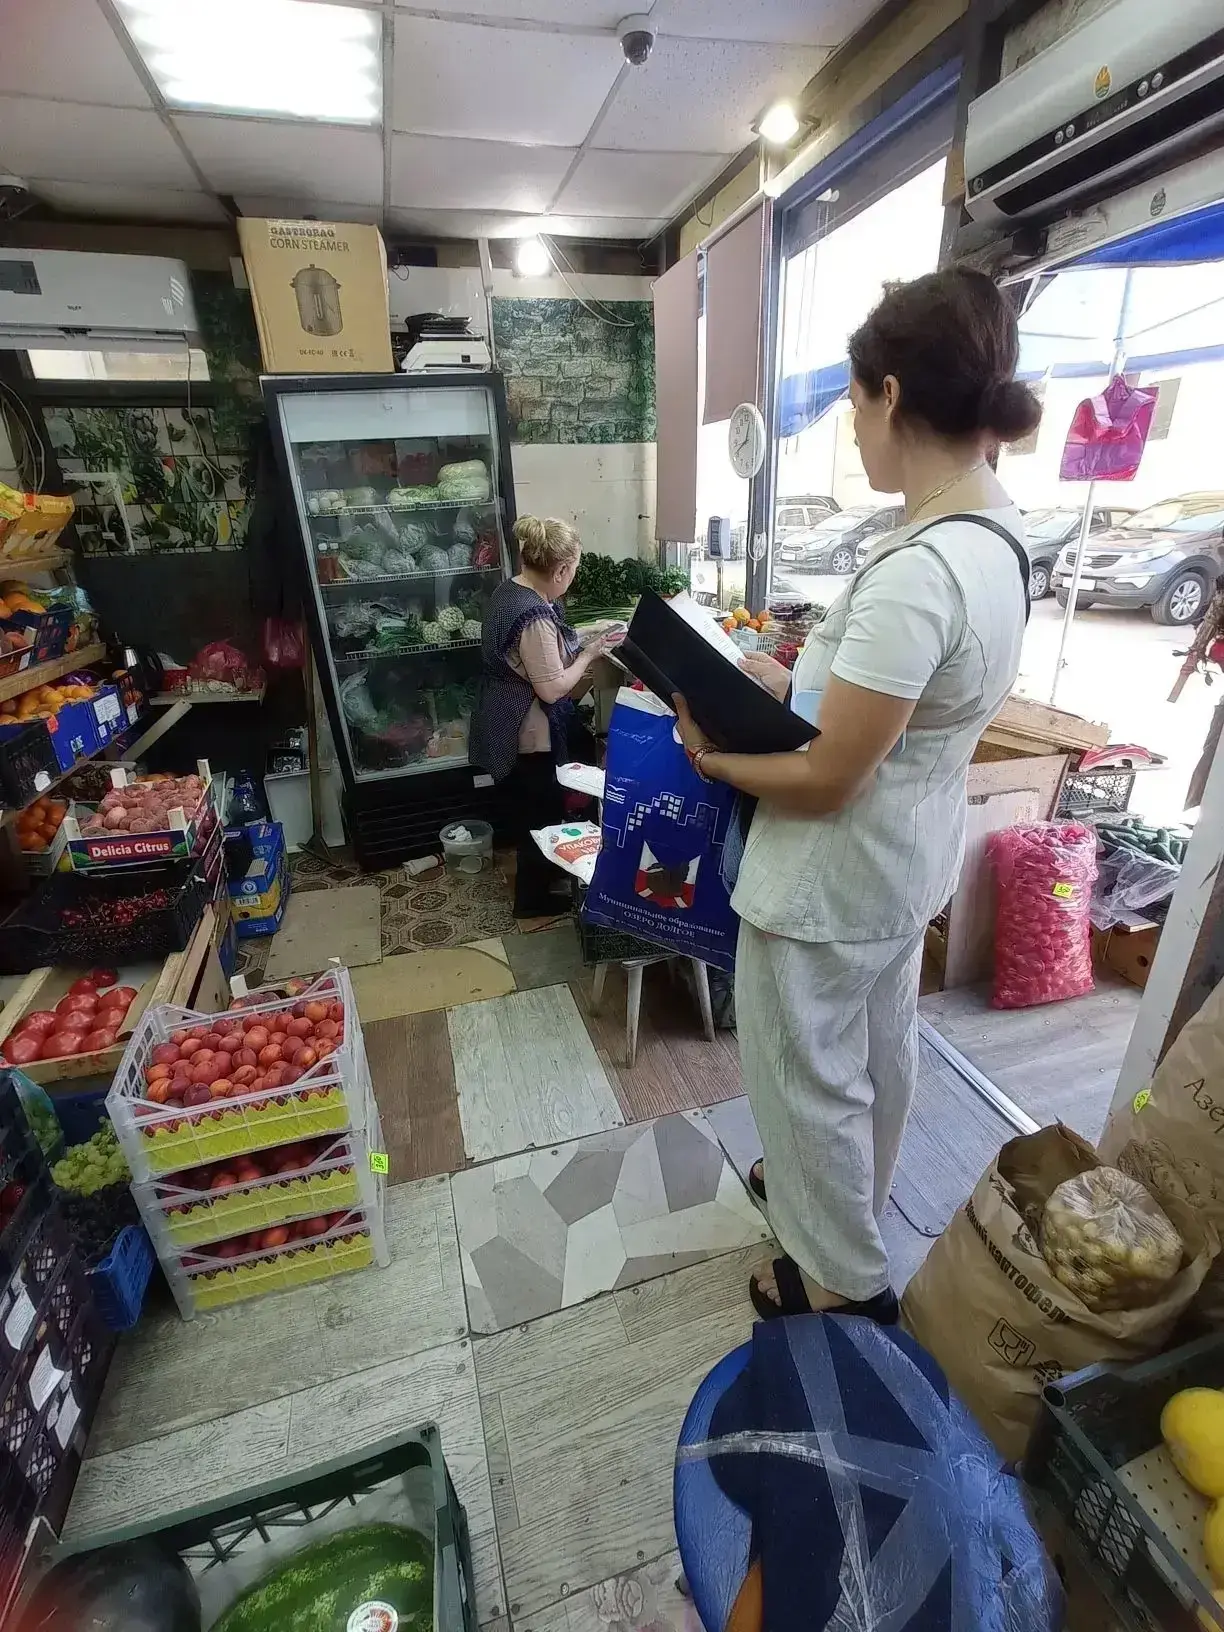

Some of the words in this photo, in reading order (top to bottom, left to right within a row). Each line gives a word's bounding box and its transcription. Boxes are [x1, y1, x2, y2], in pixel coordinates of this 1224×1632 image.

[269, 238, 301, 250] CORN
[301, 239, 350, 252] STEAMER
[91, 844, 132, 857] Delicia
[134, 842, 170, 854] Citrus
[558, 836, 601, 851] УПАКОВ
[598, 892, 667, 922] Муниципальное
[668, 915, 726, 937] образование
[623, 910, 655, 927] ОЗЕРО
[655, 921, 696, 938] ДОЛГОЕ
[989, 1239, 1070, 1325] картофел
